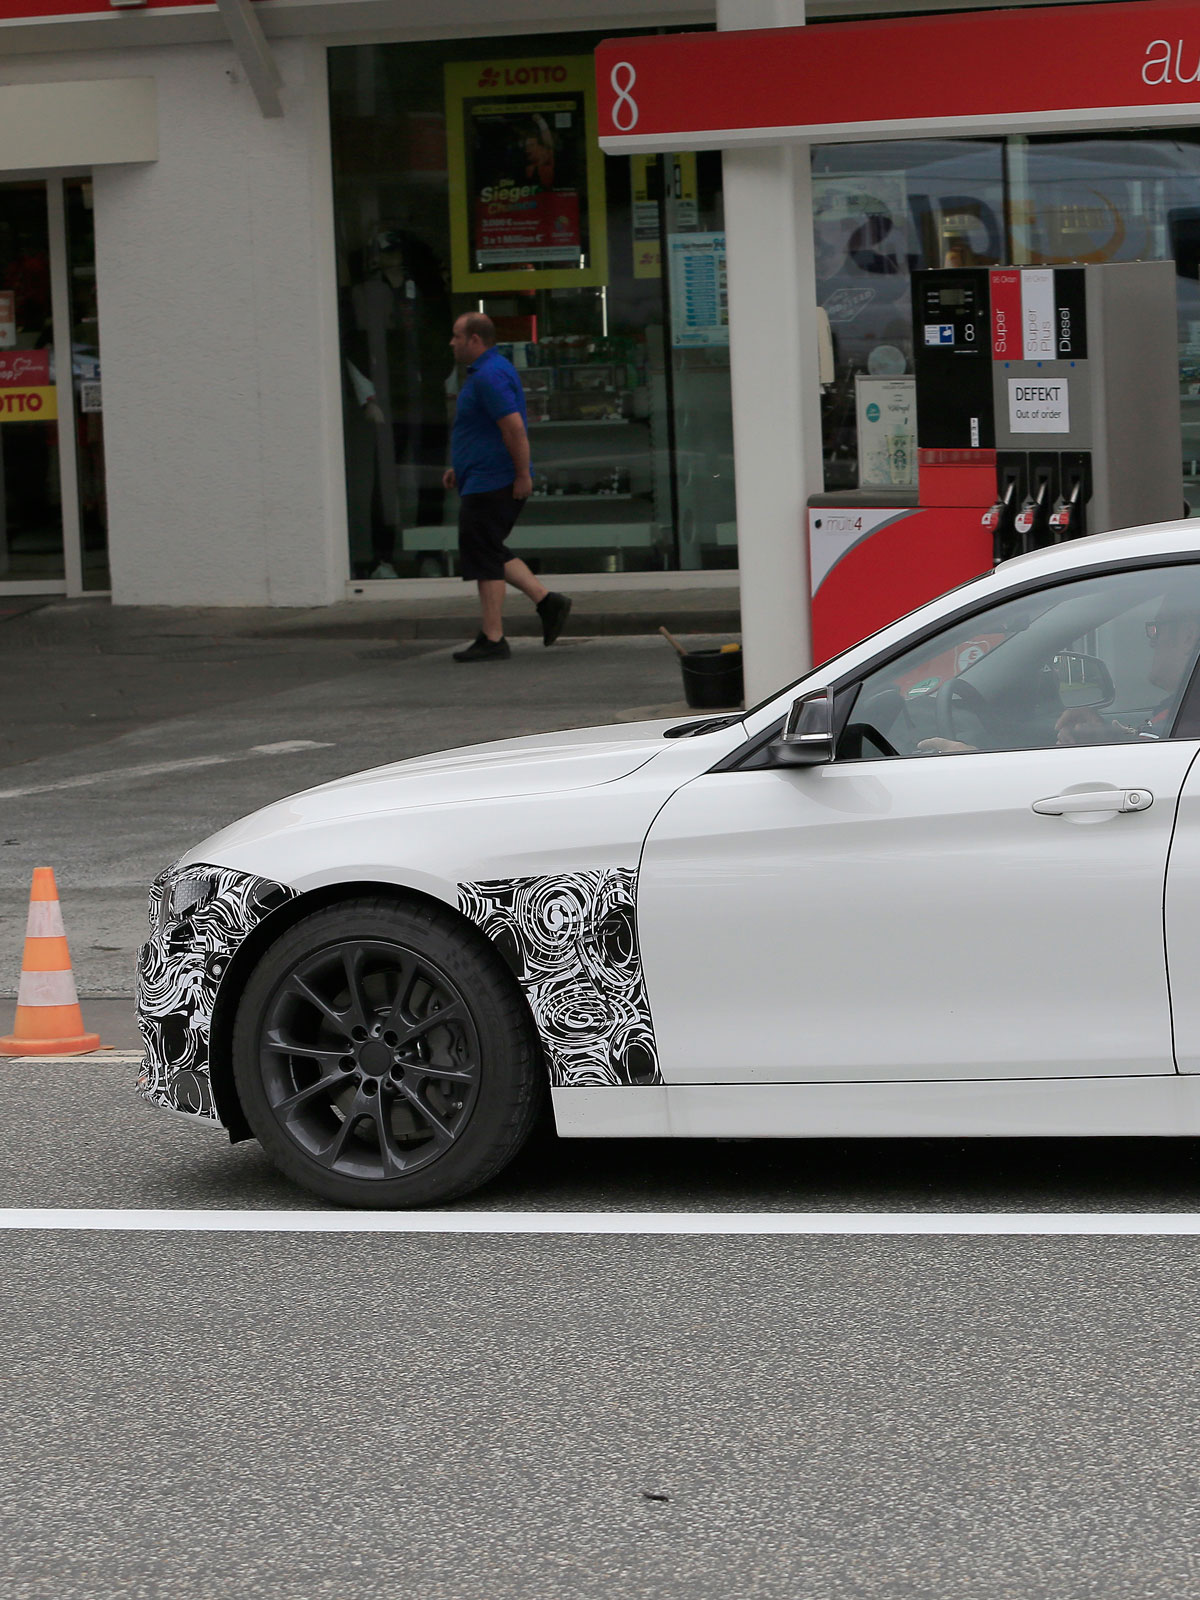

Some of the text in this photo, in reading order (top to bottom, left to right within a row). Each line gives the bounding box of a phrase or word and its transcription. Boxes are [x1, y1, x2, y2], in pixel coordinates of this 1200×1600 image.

[505, 65, 567, 87] LOTTO
[610, 61, 639, 131] 8
[480, 184, 539, 202] Sieger
[964, 323, 975, 342] 8
[995, 309, 1009, 353] Super
[1027, 309, 1039, 352] Super
[1041, 321, 1052, 352] Plus
[1058, 307, 1072, 352] Diesel
[0, 393, 43, 412] TTO
[1015, 387, 1061, 401] DEFEKT
[1016, 408, 1062, 419] Out of order
